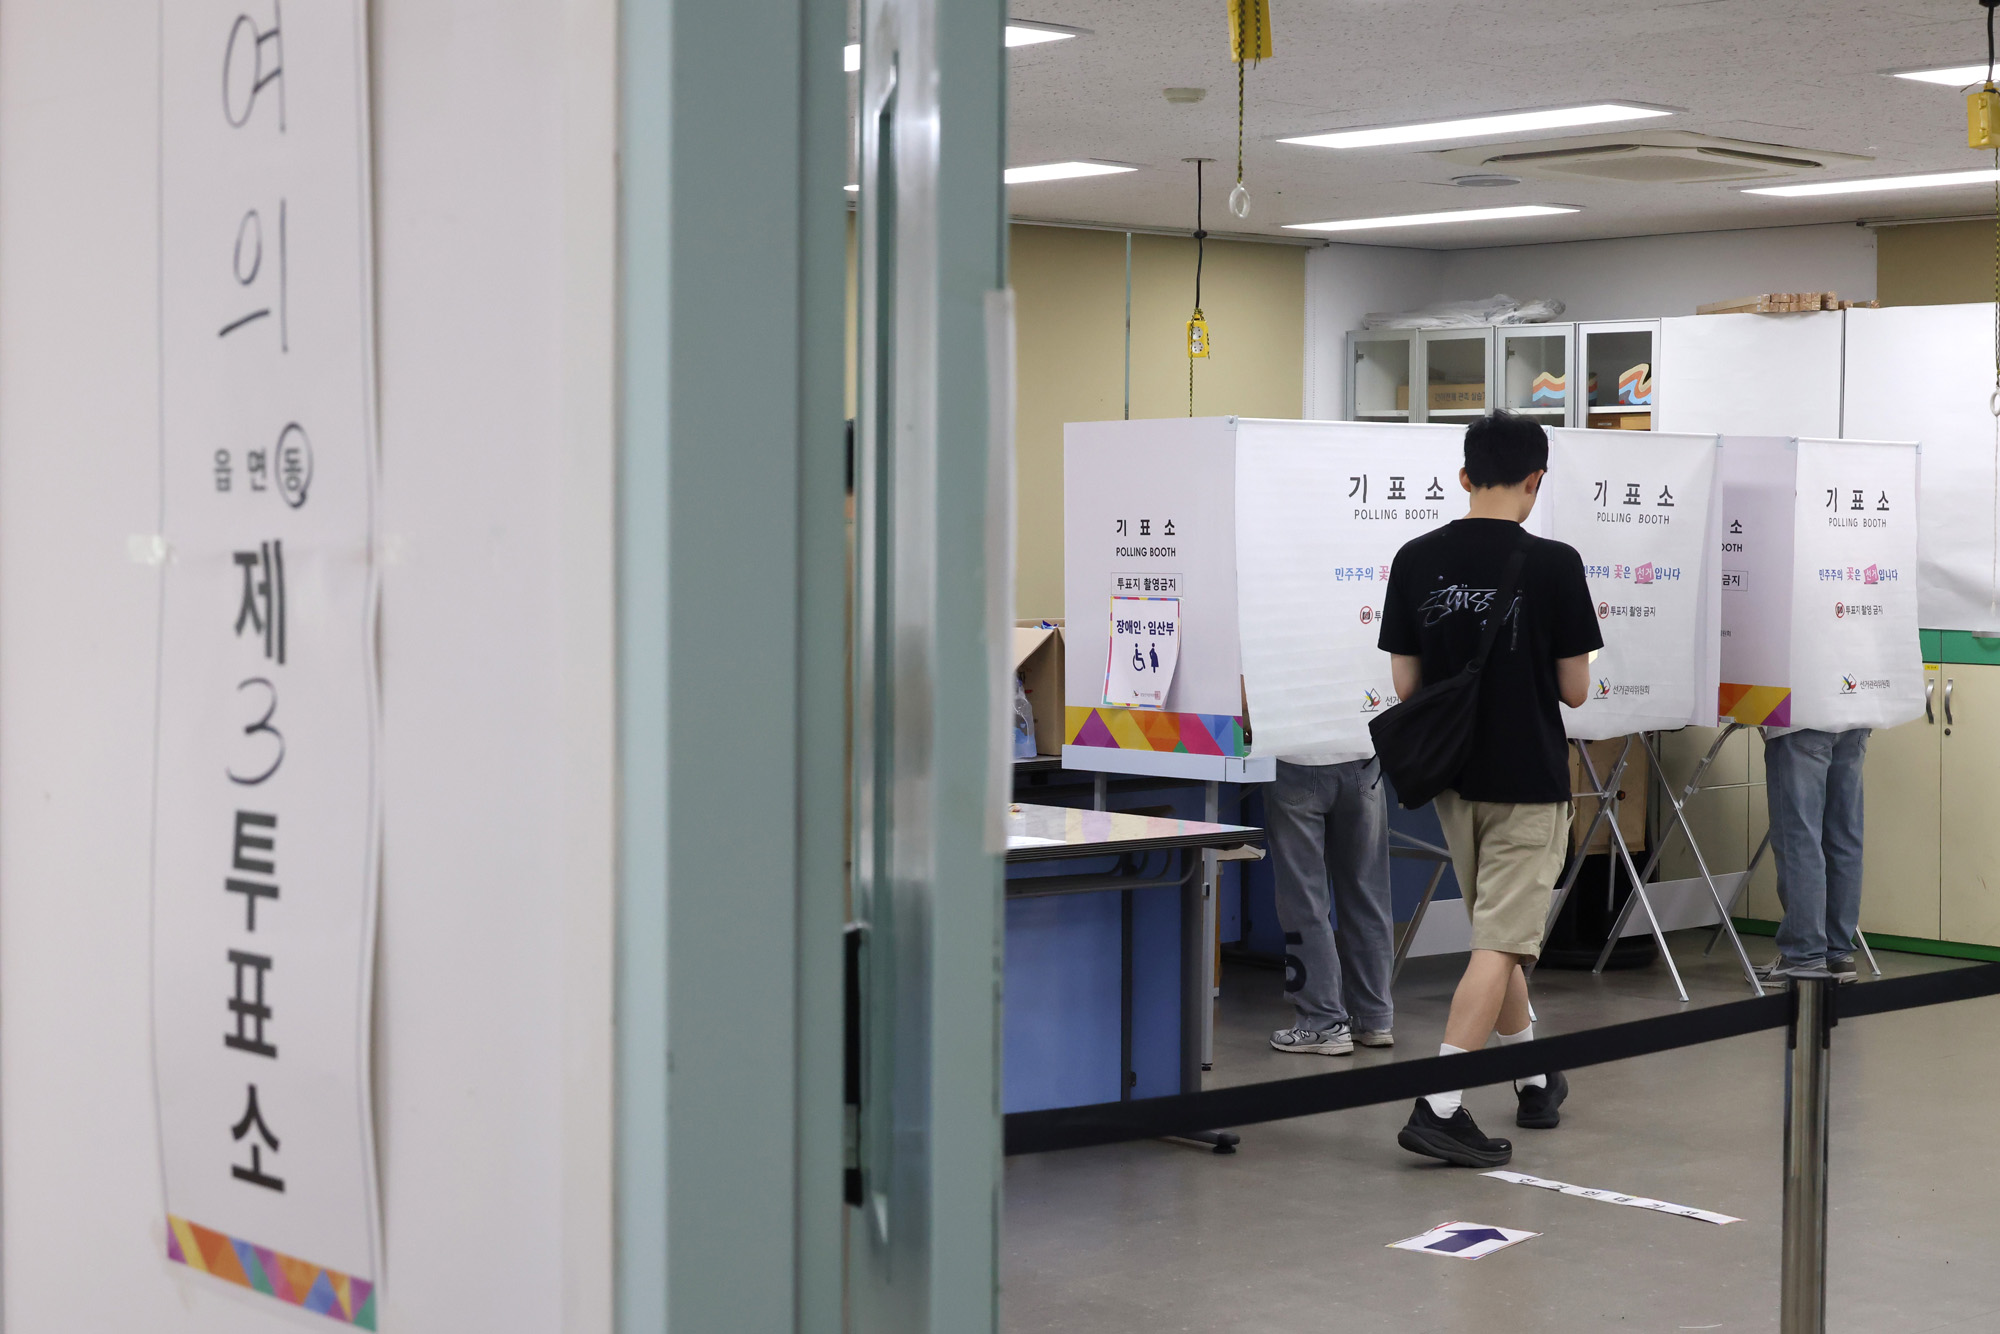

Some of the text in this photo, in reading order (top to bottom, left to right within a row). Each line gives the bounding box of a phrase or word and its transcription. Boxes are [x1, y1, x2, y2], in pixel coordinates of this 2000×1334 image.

[246, 446, 267, 492] 면
[283, 447, 303, 492] 동
[1354, 509, 1439, 520] POLLING BOOTH
[1596, 511, 1670, 525] POLLING BOOTH
[1828, 517, 1887, 528] POLLING BOOTH
[1116, 547, 1176, 557] POLLING BOOTH
[1721, 542, 1743, 553] OTH
[1334, 565, 1390, 581] 민주주의 꽃
[1613, 564, 1631, 579] 꽃은
[1818, 568, 1843, 581] 민주주의
[1846, 566, 1861, 581] 꽃은
[1117, 577, 1176, 591] 투표지 촬영금지
[1721, 574, 1741, 587] 금지
[1610, 605, 1656, 617] 투표지 촬영 금지
[1845, 605, 1861, 616] 투표지
[1873, 605, 1884, 616] 금지
[1612, 685, 1650, 695] 선거관리위원회
